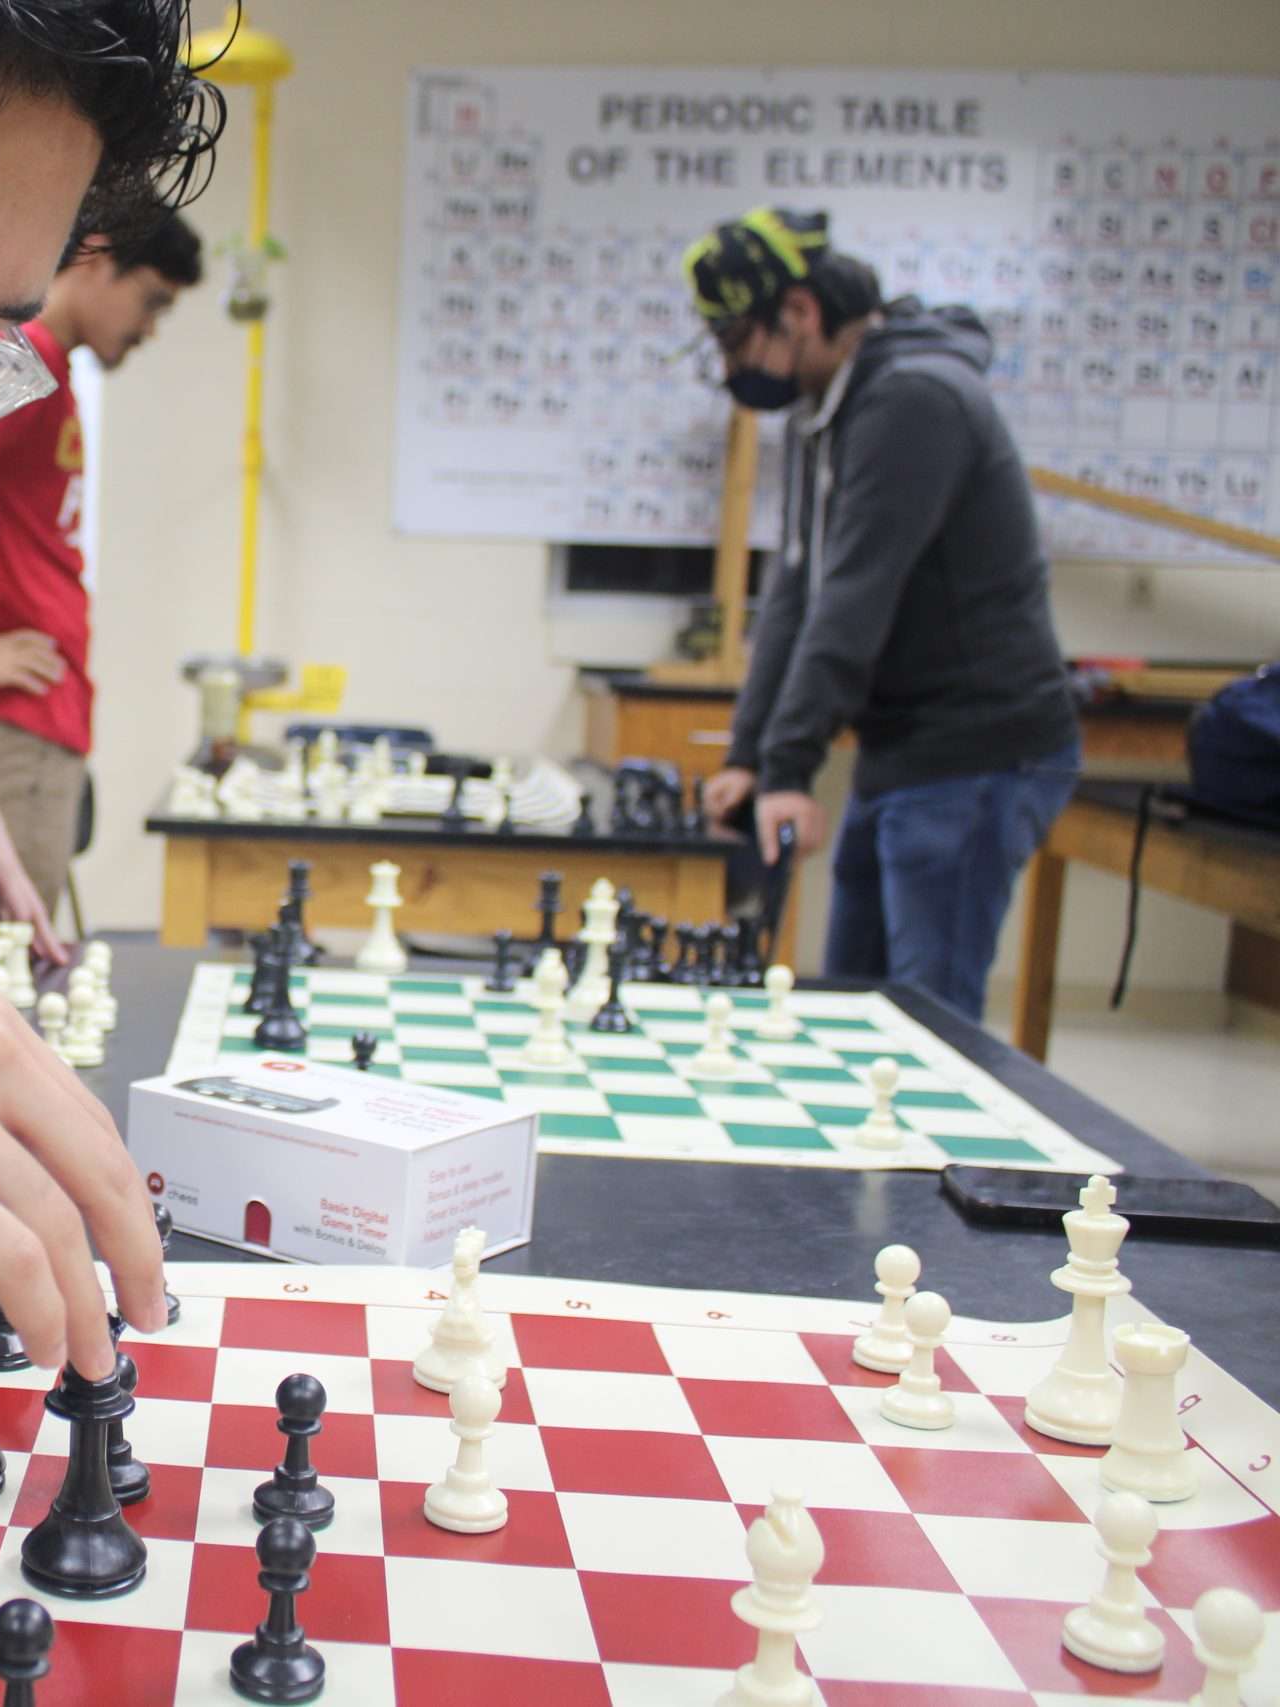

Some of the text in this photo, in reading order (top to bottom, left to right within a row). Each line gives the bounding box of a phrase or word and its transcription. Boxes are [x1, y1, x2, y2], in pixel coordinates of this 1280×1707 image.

[599, 95, 983, 136] PERIODIC TABLE
[567, 145, 628, 185] OF
[651, 148, 737, 187] THE
[764, 150, 1008, 192] ELEMENTS
[320, 1197, 389, 1225] Basic Digital
[321, 1214, 388, 1241] Game Timer
[315, 1228, 345, 1246] Bonus
[284, 1282, 308, 1294] 3
[424, 1289, 449, 1301] 4
[566, 1298, 592, 1311] 5
[1248, 1454, 1272, 1472] c
